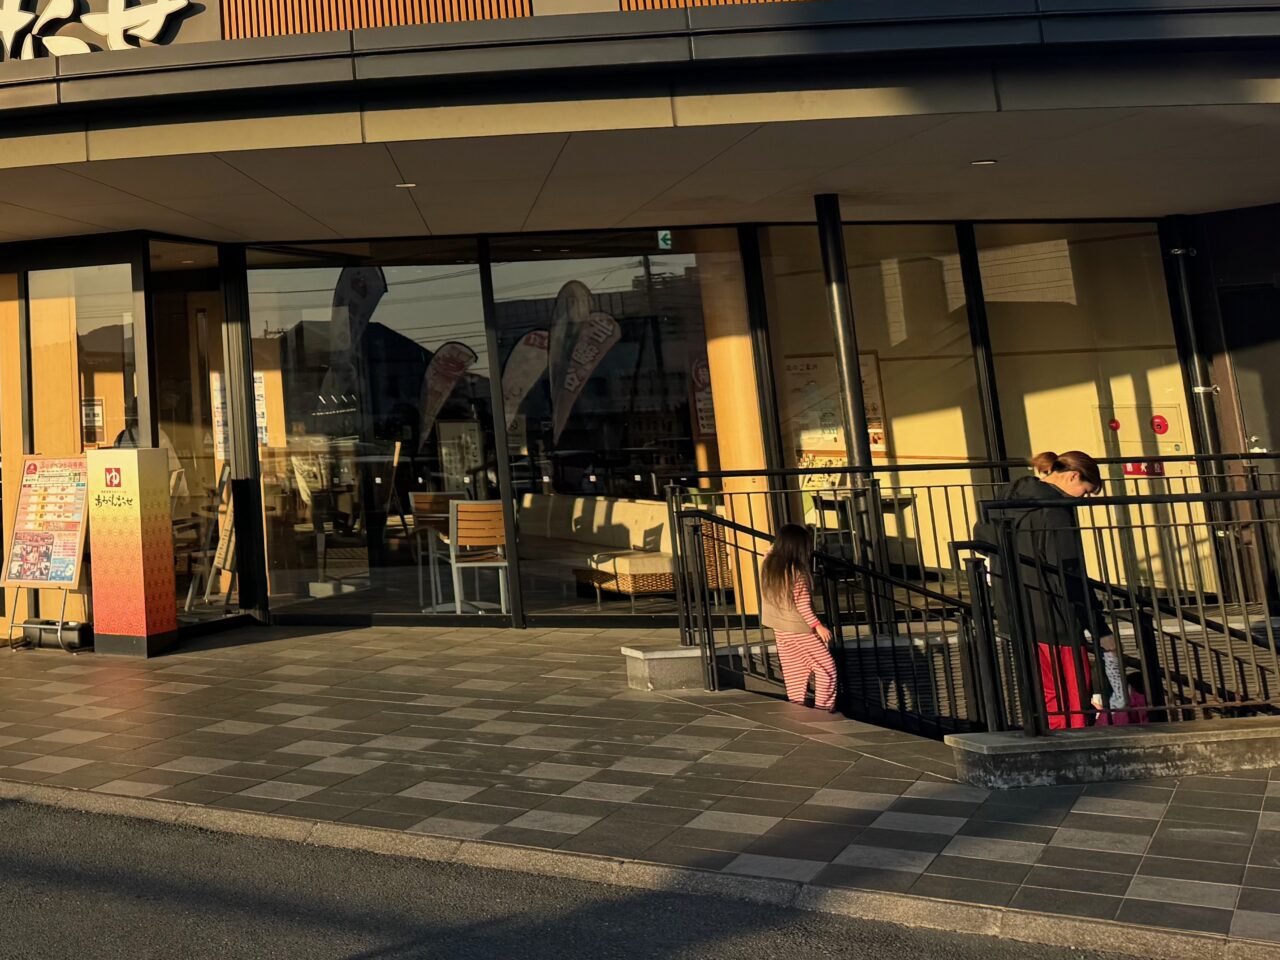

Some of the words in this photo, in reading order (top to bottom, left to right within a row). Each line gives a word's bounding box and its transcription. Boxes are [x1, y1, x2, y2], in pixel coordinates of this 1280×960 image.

[106, 469, 120, 486] ゆ
[95, 494, 133, 507] あがんなっせ
